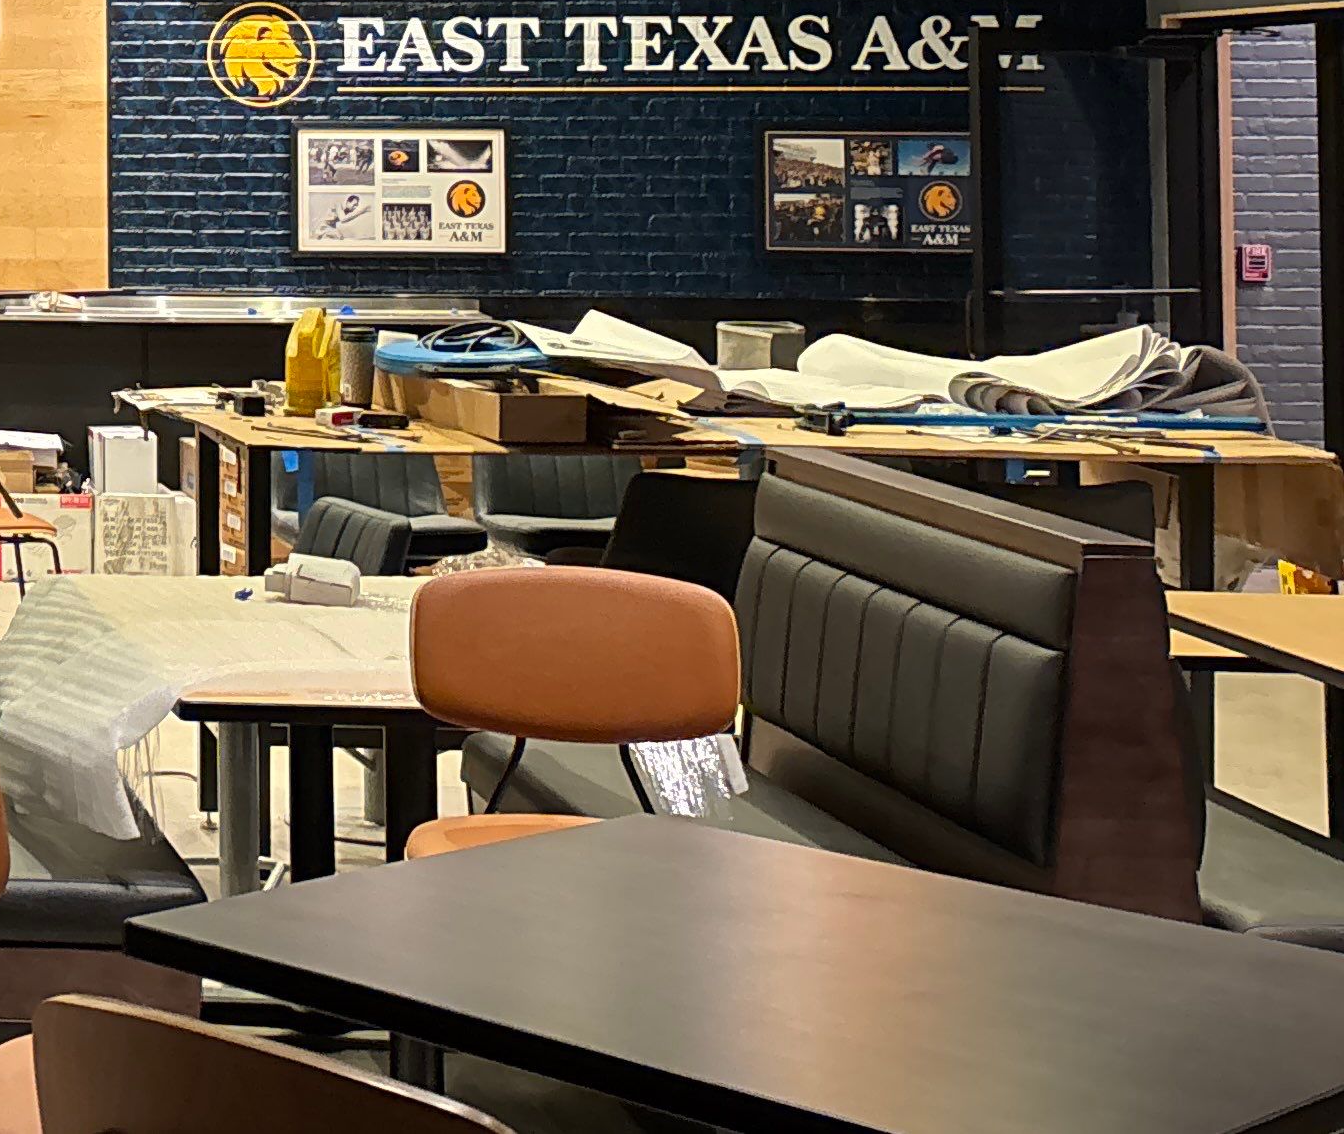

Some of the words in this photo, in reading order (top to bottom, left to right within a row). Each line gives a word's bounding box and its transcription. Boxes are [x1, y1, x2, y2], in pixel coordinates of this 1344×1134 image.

[337, 16, 540, 72] EAST
[565, 15, 833, 72] TEXAS
[438, 222, 462, 230] EAST
[465, 222, 494, 230] TEXAS
[449, 231, 483, 242] A&M
[922, 233, 959, 246] A&M
